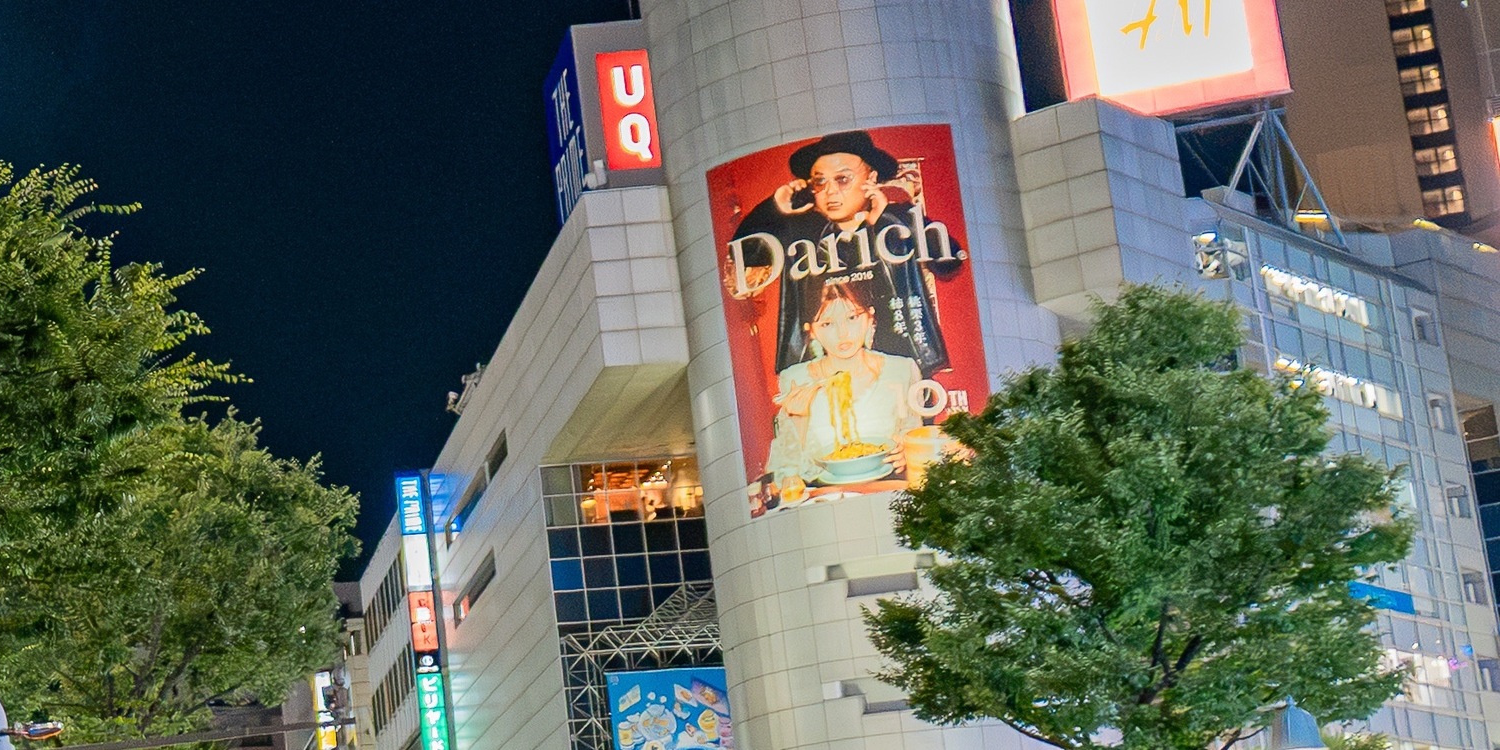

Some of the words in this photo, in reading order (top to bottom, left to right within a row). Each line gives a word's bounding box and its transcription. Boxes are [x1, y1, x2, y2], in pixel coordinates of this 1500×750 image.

[551, 68, 574, 148] THE
[611, 64, 654, 162] UQ
[850, 270, 874, 282] 2016
